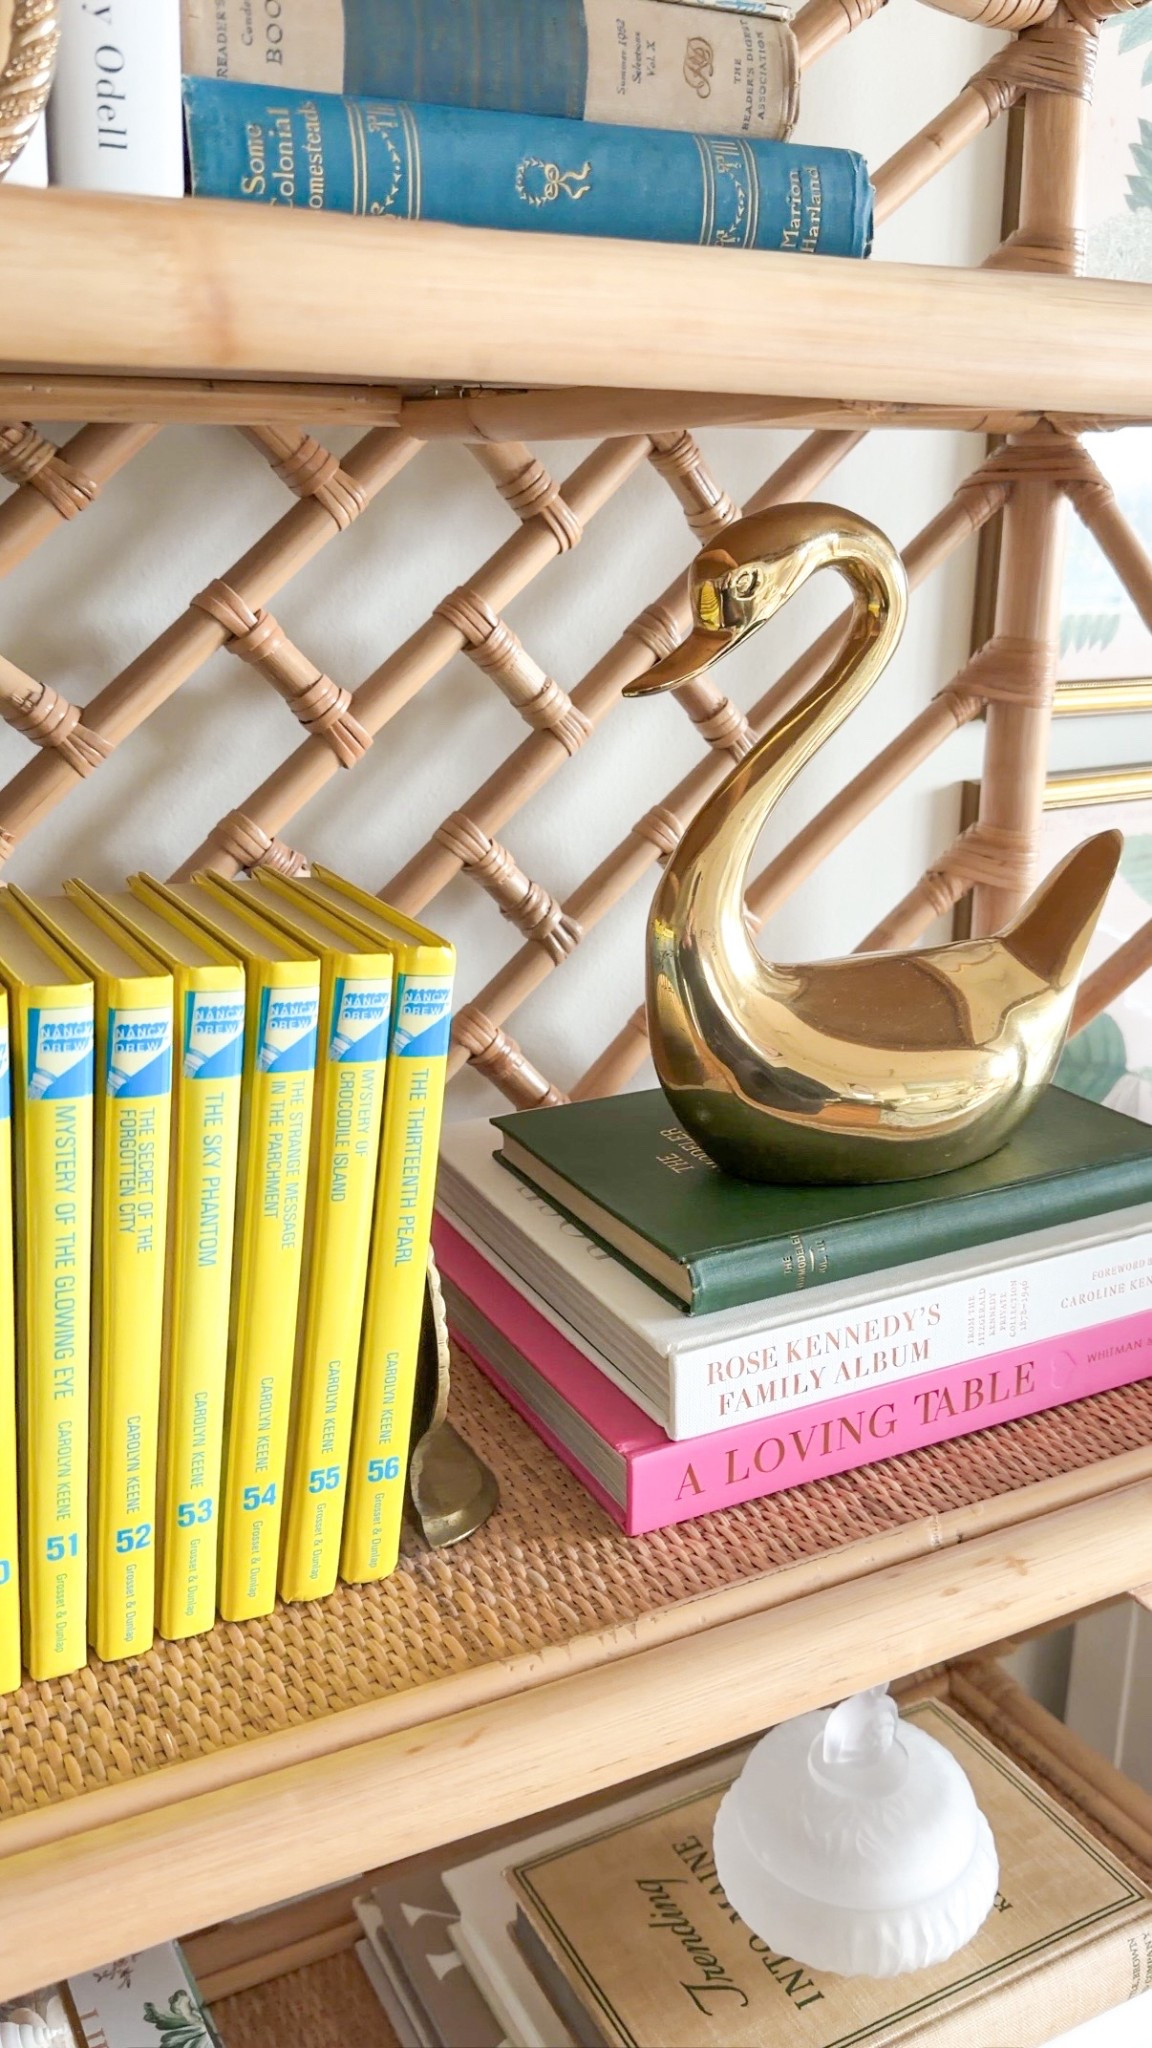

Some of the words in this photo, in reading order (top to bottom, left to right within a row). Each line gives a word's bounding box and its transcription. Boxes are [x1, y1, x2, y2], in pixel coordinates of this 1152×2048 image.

[739, 18, 755, 63] DIGEST
[616, 50, 628, 96] Summer
[733, 58, 742, 85] THE
[756, 30, 769, 121] ASSOCIATION
[94, 45, 128, 150] Odell
[742, 67, 756, 132] READER'S
[241, 121, 266, 196] Some
[296, 99, 325, 210] omesteads
[780, 169, 802, 249] Marion
[801, 165, 820, 254] Harland
[270, 1001, 318, 1016] NANCY
[343, 991, 390, 1006] NANCY
[402, 1002, 447, 1016] DREW
[404, 987, 450, 1002] NANCY
[40, 1022, 93, 1039] NANCY
[194, 1006, 244, 1021] NANCY
[194, 1021, 238, 1035] DREW
[270, 1016, 314, 1029] DREW
[341, 1006, 387, 1020] DREW
[41, 1040, 89, 1053] DREW
[115, 1023, 170, 1039] NANCY
[115, 1040, 163, 1053] DREW
[271, 1081, 286, 1097] IN
[290, 1078, 305, 1106] THE
[357, 1069, 375, 1134] MYSTERY
[410, 1067, 429, 1101] THE
[138, 1107, 155, 1136] THE
[203, 1091, 224, 1126] THE
[269, 1100, 286, 1127] THE
[335, 1070, 356, 1148] CROCODILE
[55, 1105, 77, 1194] MYSTERY
[119, 1109, 137, 1196] FORGOTTEN
[202, 1134, 223, 1169] SKY
[286, 1110, 304, 1177] STRANGE
[355, 1141, 369, 1157] OF
[401, 1107, 426, 1210] THIRTEENTH
[137, 1141, 155, 1195] SECRET
[264, 1132, 284, 1219] PARCHMENT
[331, 1152, 349, 1202] ISLAND
[656, 1152, 696, 1174] THE
[54, 1200, 76, 1227] OF
[118, 1202, 136, 1234] CITY
[137, 1200, 154, 1222] OF
[198, 1176, 221, 1268] PHANTOM
[282, 1181, 300, 1251] MESSAGE
[54, 1232, 76, 1269] THE
[137, 1226, 153, 1254] THE
[395, 1214, 415, 1268] PEARL
[783, 1255, 793, 1275] THE
[1091, 1259, 1146, 1281] FOREWORD
[967, 1296, 975, 1316] THE
[999, 1292, 1007, 1331] PRIVATE
[1009, 1280, 1017, 1338] COLLECTION
[1060, 1283, 1125, 1310] CAROLINE
[54, 1275, 76, 1360] GLOWING
[978, 1288, 986, 1346] FITZGERALD
[707, 1346, 778, 1386] ROSE
[786, 1303, 941, 1364] KENNEDY'S
[1087, 1339, 1143, 1363] WHITMAN
[54, 1367, 75, 1400] EYE
[324, 1360, 341, 1413] CAROLYN
[383, 1352, 399, 1405] CAROLYN
[718, 1367, 826, 1416] FAMILY
[834, 1338, 931, 1384] ALBUM
[192, 1391, 208, 1447] CAROLYN
[258, 1377, 274, 1431] CAROLYN
[126, 1415, 141, 1470] CAROLYN
[322, 1417, 336, 1455] KEENE
[379, 1409, 394, 1445] KEENE
[675, 1462, 706, 1501] A
[724, 1403, 898, 1486] LOVING
[914, 1361, 1036, 1426] TABLE
[57, 1420, 72, 1477] CAROLYN
[255, 1435, 269, 1473] KEENE
[190, 1451, 205, 1490] KEENE
[308, 1466, 340, 1493] 55
[367, 1456, 399, 1483] 56
[56, 1482, 71, 1521] KEENE
[126, 1476, 140, 1514] KEENE
[176, 1497, 213, 1528] 53
[243, 1483, 276, 1511] 54
[373, 1492, 385, 1528] Grosset
[115, 1523, 151, 1553] 52
[251, 1520, 263, 1555] Grosset
[314, 1503, 326, 1538] Grosset
[46, 1533, 78, 1561] 51
[189, 1539, 201, 1573] Grosset
[310, 1549, 323, 1580] Dunlap
[368, 1538, 381, 1568] Dunlap
[56, 1573, 67, 1608] Grosset
[126, 1564, 137, 1597] Grosset
[249, 1568, 260, 1598] Dunlap
[185, 1585, 198, 1617] Dunlap
[55, 1622, 67, 1653] Dunlap
[125, 1612, 137, 1643] Dunlap
[635, 1878, 749, 2016] Trending
[749, 1934, 825, 2012] INTO
